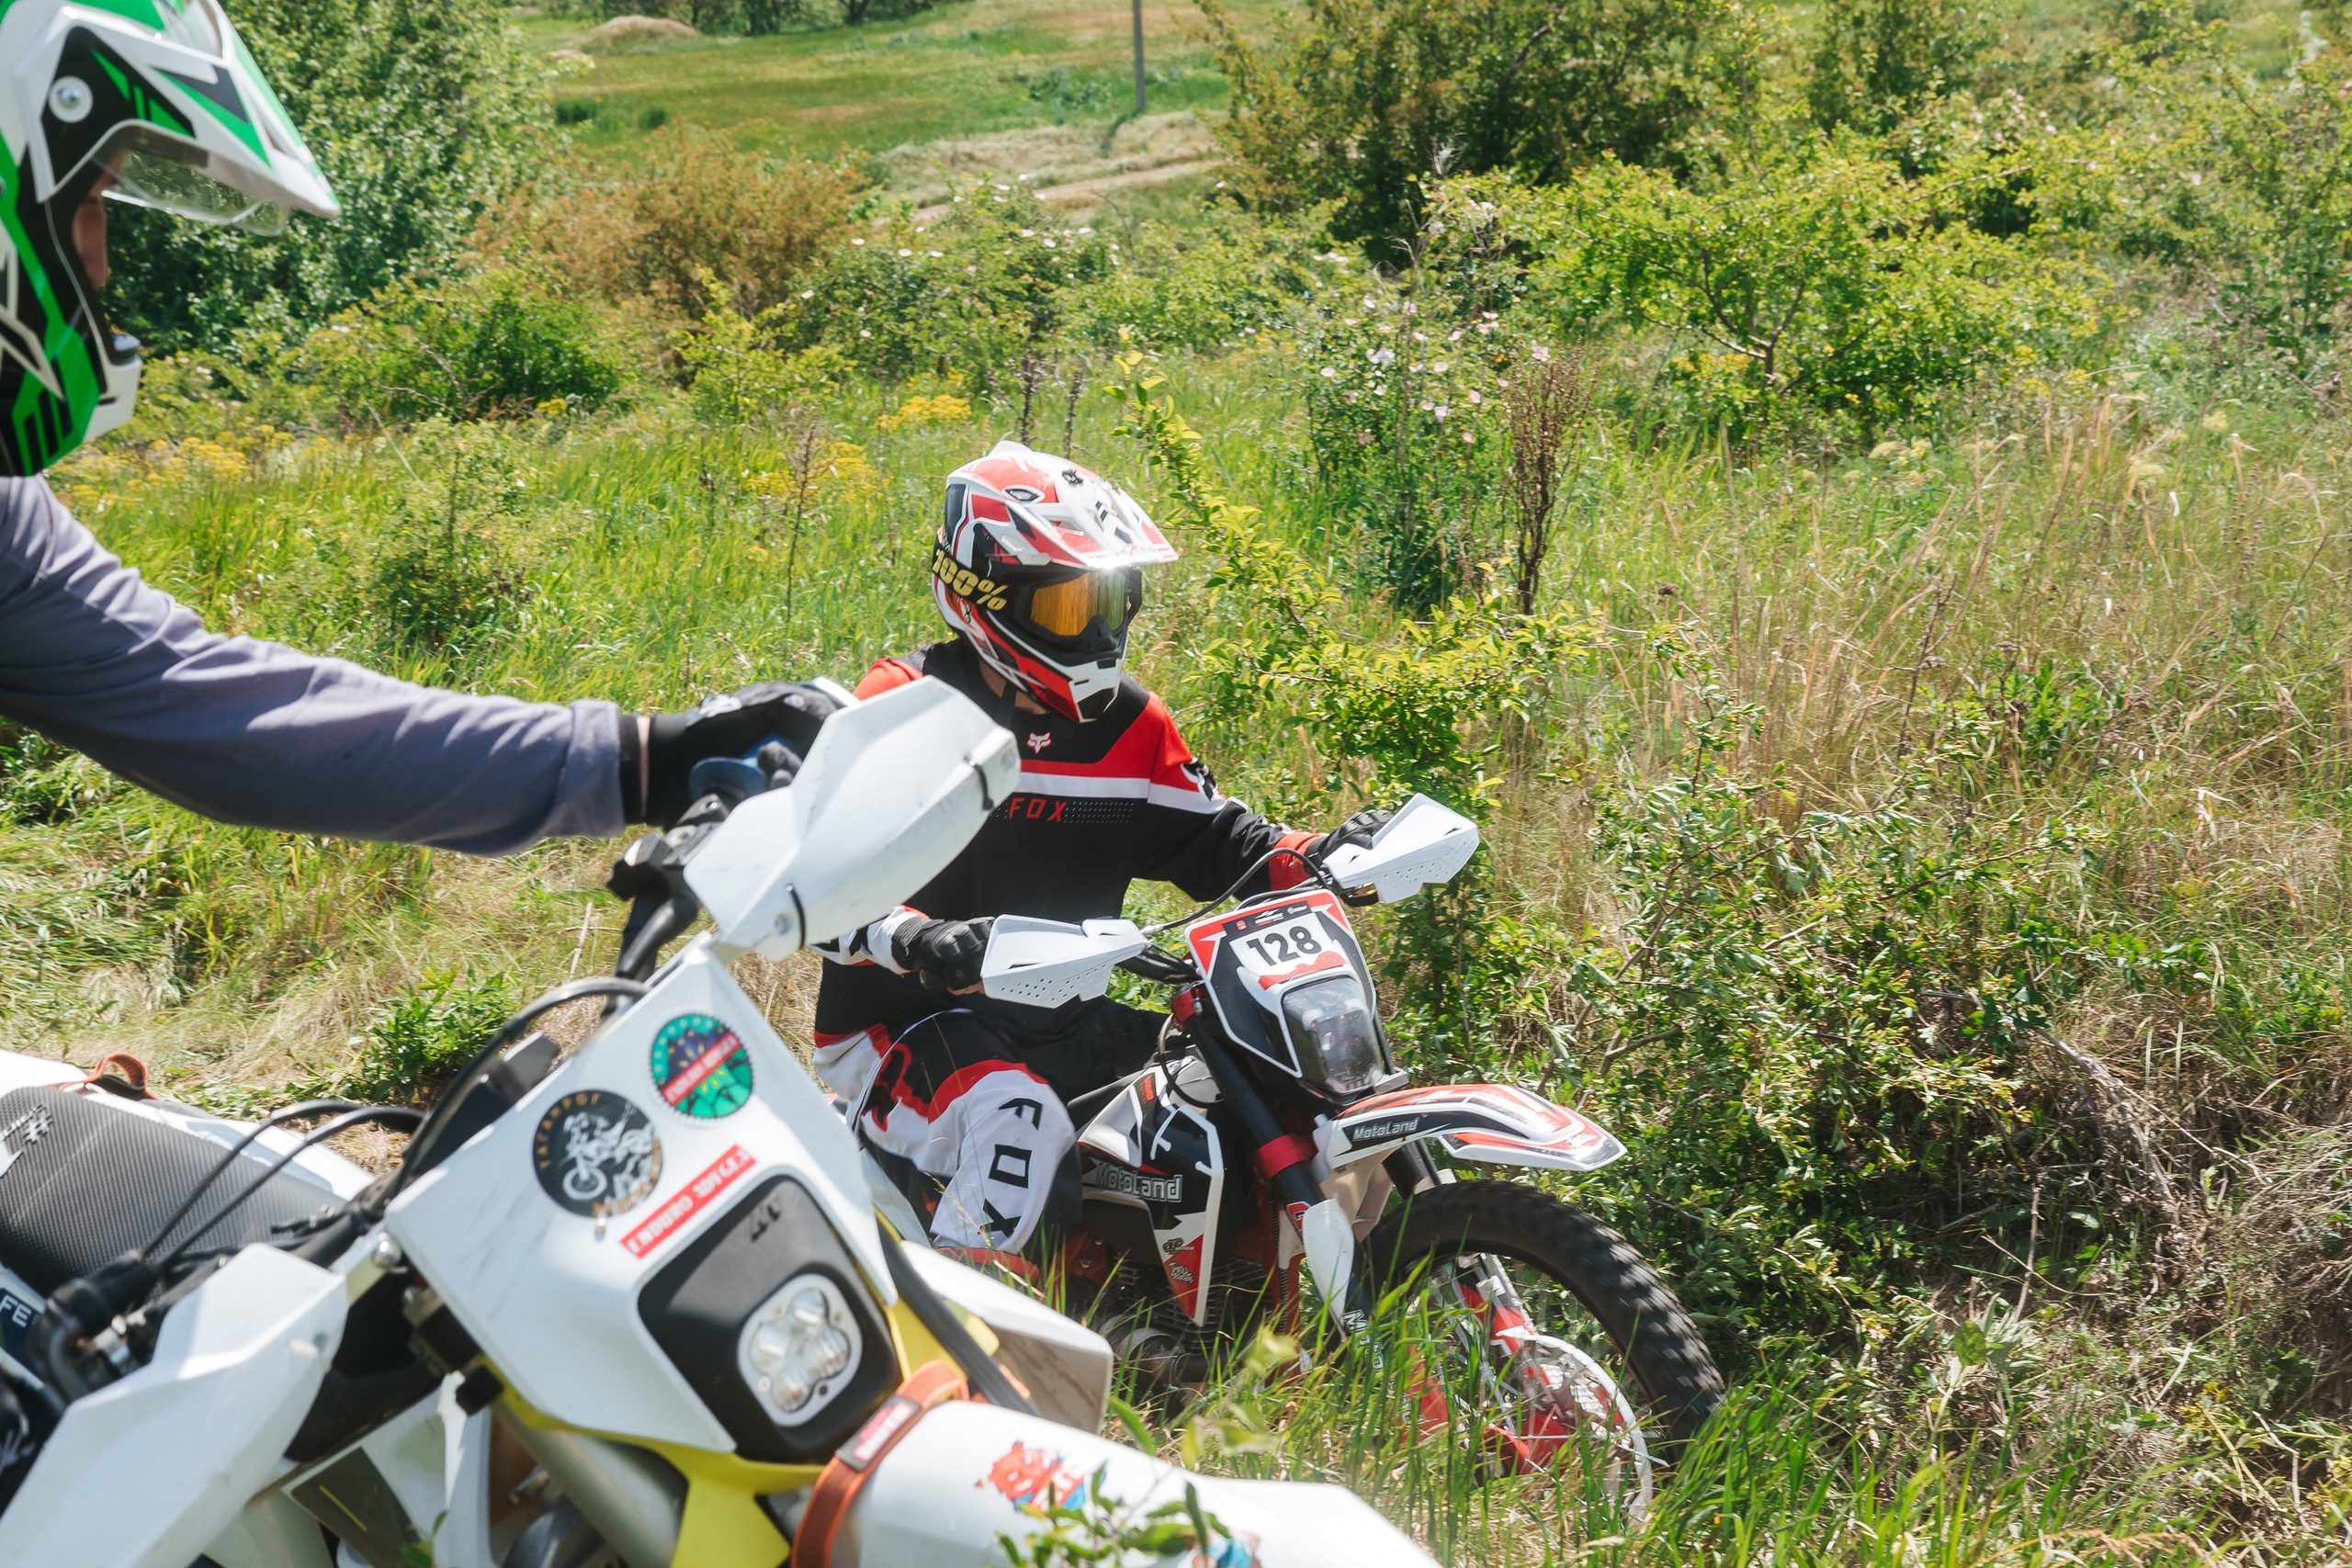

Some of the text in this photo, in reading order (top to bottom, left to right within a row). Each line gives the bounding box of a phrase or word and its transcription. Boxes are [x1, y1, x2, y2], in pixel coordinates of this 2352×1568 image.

[932, 548, 1009, 611] 100%
[1009, 797, 1068, 823] FOX
[1246, 926, 1322, 966] 128
[1351, 1117, 1420, 1142] MotoLand
[978, 1097, 1044, 1240] FOX
[1095, 1161, 1183, 1203] MotoLand
